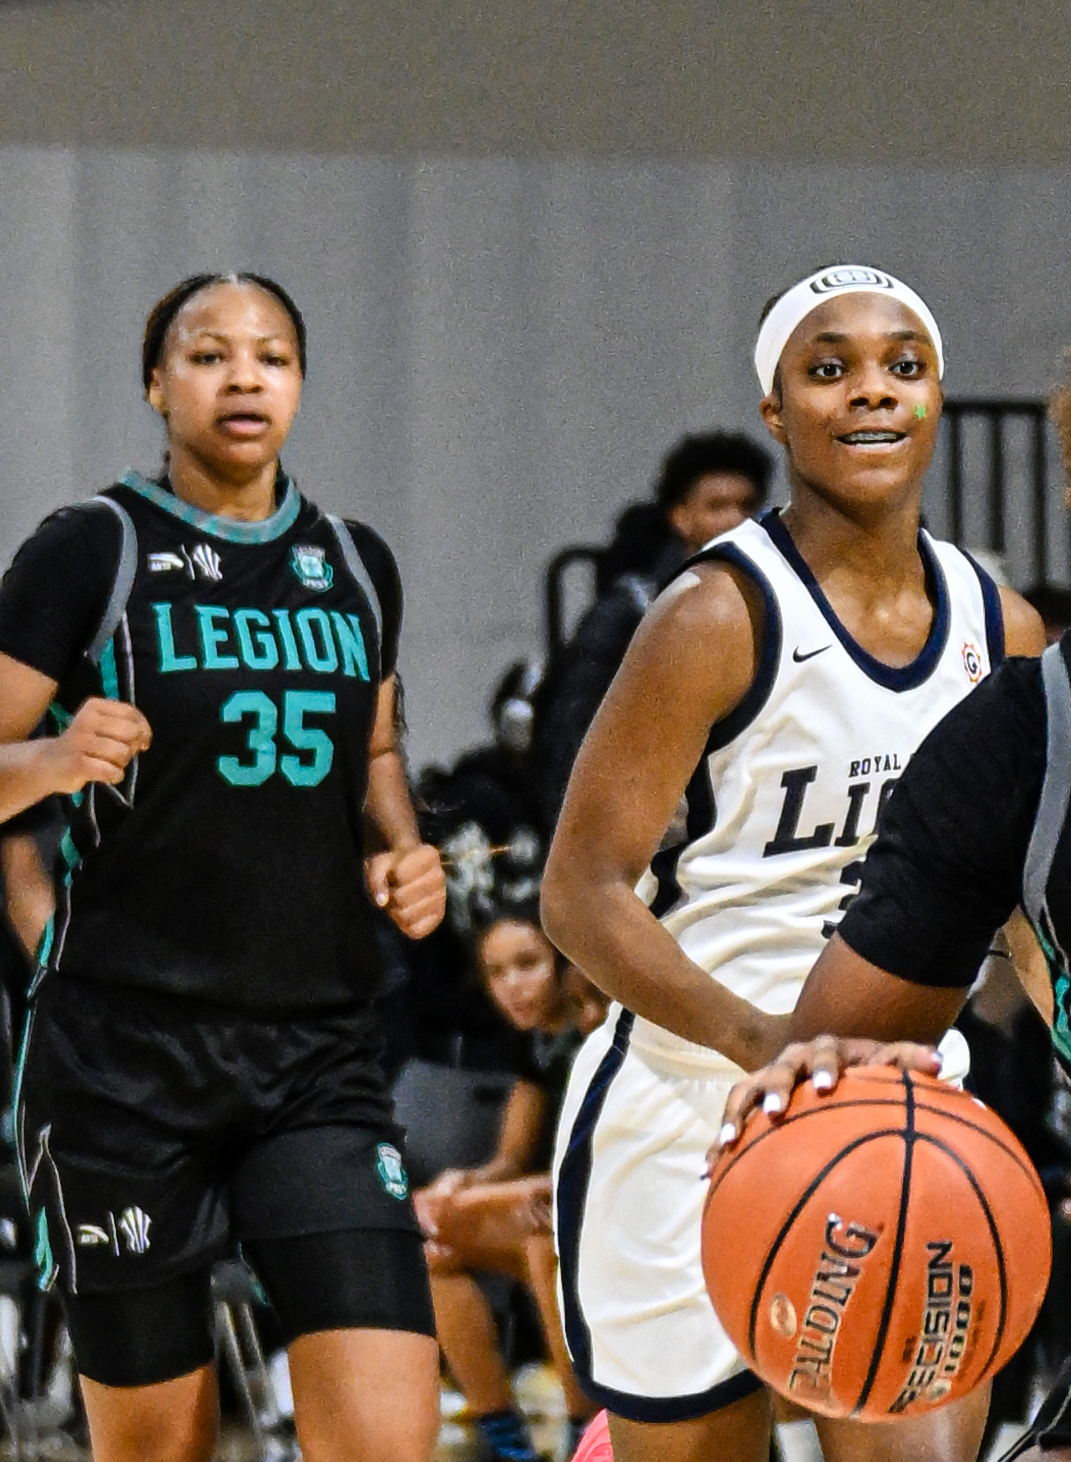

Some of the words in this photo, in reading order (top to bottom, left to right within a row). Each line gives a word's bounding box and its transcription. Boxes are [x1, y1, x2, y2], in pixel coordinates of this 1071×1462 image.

[152, 601, 371, 682] LEGION
[218, 689, 336, 787] 35
[848, 753, 902, 778] ROYAL
